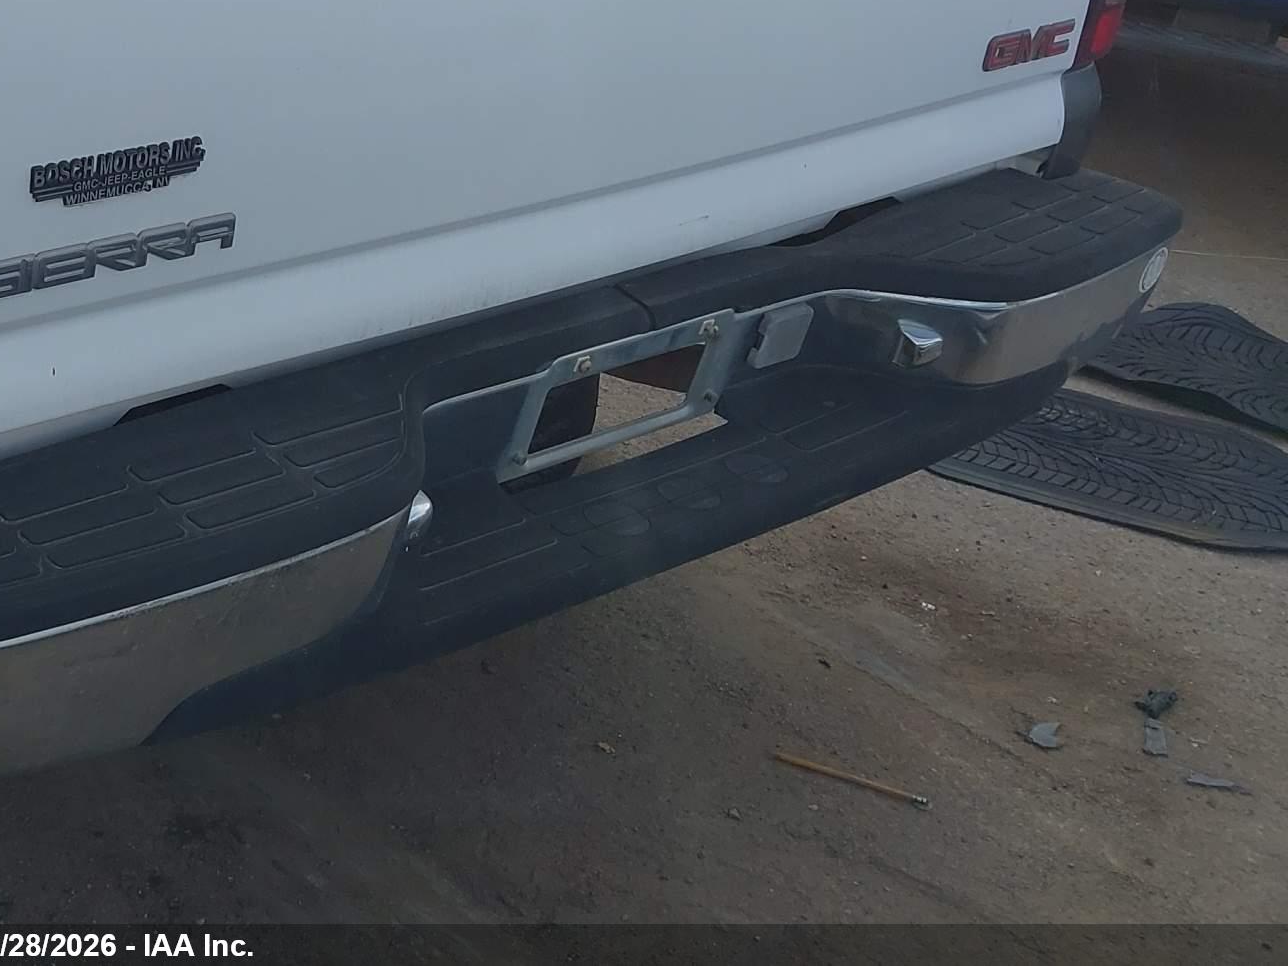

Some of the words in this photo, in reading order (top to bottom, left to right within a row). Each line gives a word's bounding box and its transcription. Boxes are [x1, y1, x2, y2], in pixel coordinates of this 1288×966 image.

[982, 18, 1075, 72] GMC
[30, 155, 95, 191] BOSCH
[98, 141, 171, 180] MOTORS
[73, 165, 166, 192] GMC-JEEP-EAGLE
